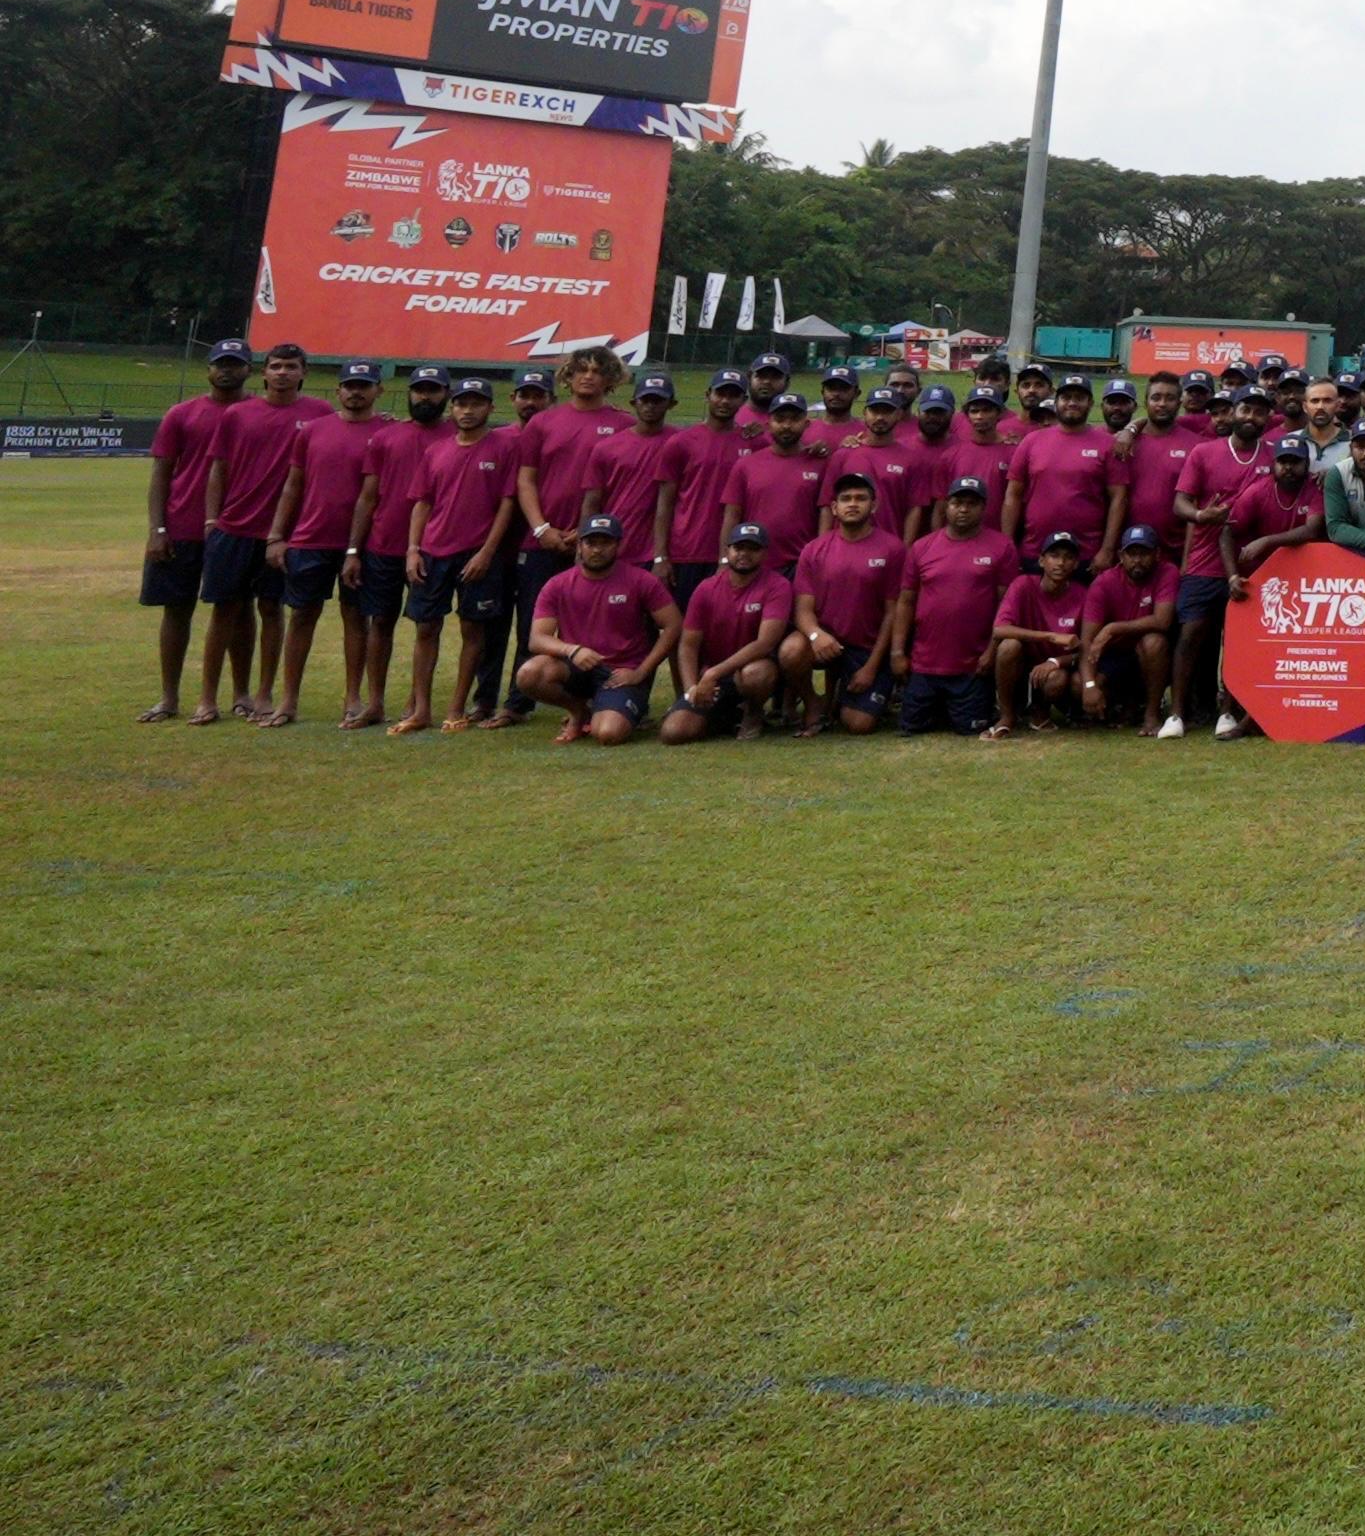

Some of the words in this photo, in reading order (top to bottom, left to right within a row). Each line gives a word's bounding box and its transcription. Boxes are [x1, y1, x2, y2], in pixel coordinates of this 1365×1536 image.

[368, 1, 414, 21] TIGERS
[488, 13, 670, 58] PROPERTIES
[450, 83, 576, 113] TIGEREXCH
[348, 153, 383, 164] GLOBAL
[384, 157, 424, 168] PARTNER
[473, 162, 530, 178] LANKA
[346, 170, 421, 187] ZIMBABWE
[555, 187, 612, 200] TIGEREXCH
[318, 263, 482, 289] CRICKET'S
[484, 274, 611, 296] FASTEST
[404, 294, 528, 316] FORMAT
[81, 426, 124, 437] VALLEY
[4, 437, 54, 447] PREMIUM
[56, 436, 98, 447] CEYLON
[1302, 627, 1331, 635] SUPER
[1286, 647, 1326, 655] PRESENTED
[1275, 660, 1348, 673] ZIMBABWE
[1274, 672, 1295, 680] OPEN
[1312, 673, 1348, 681] BUSINESS
[1291, 699, 1338, 708] TIGEREXCH
